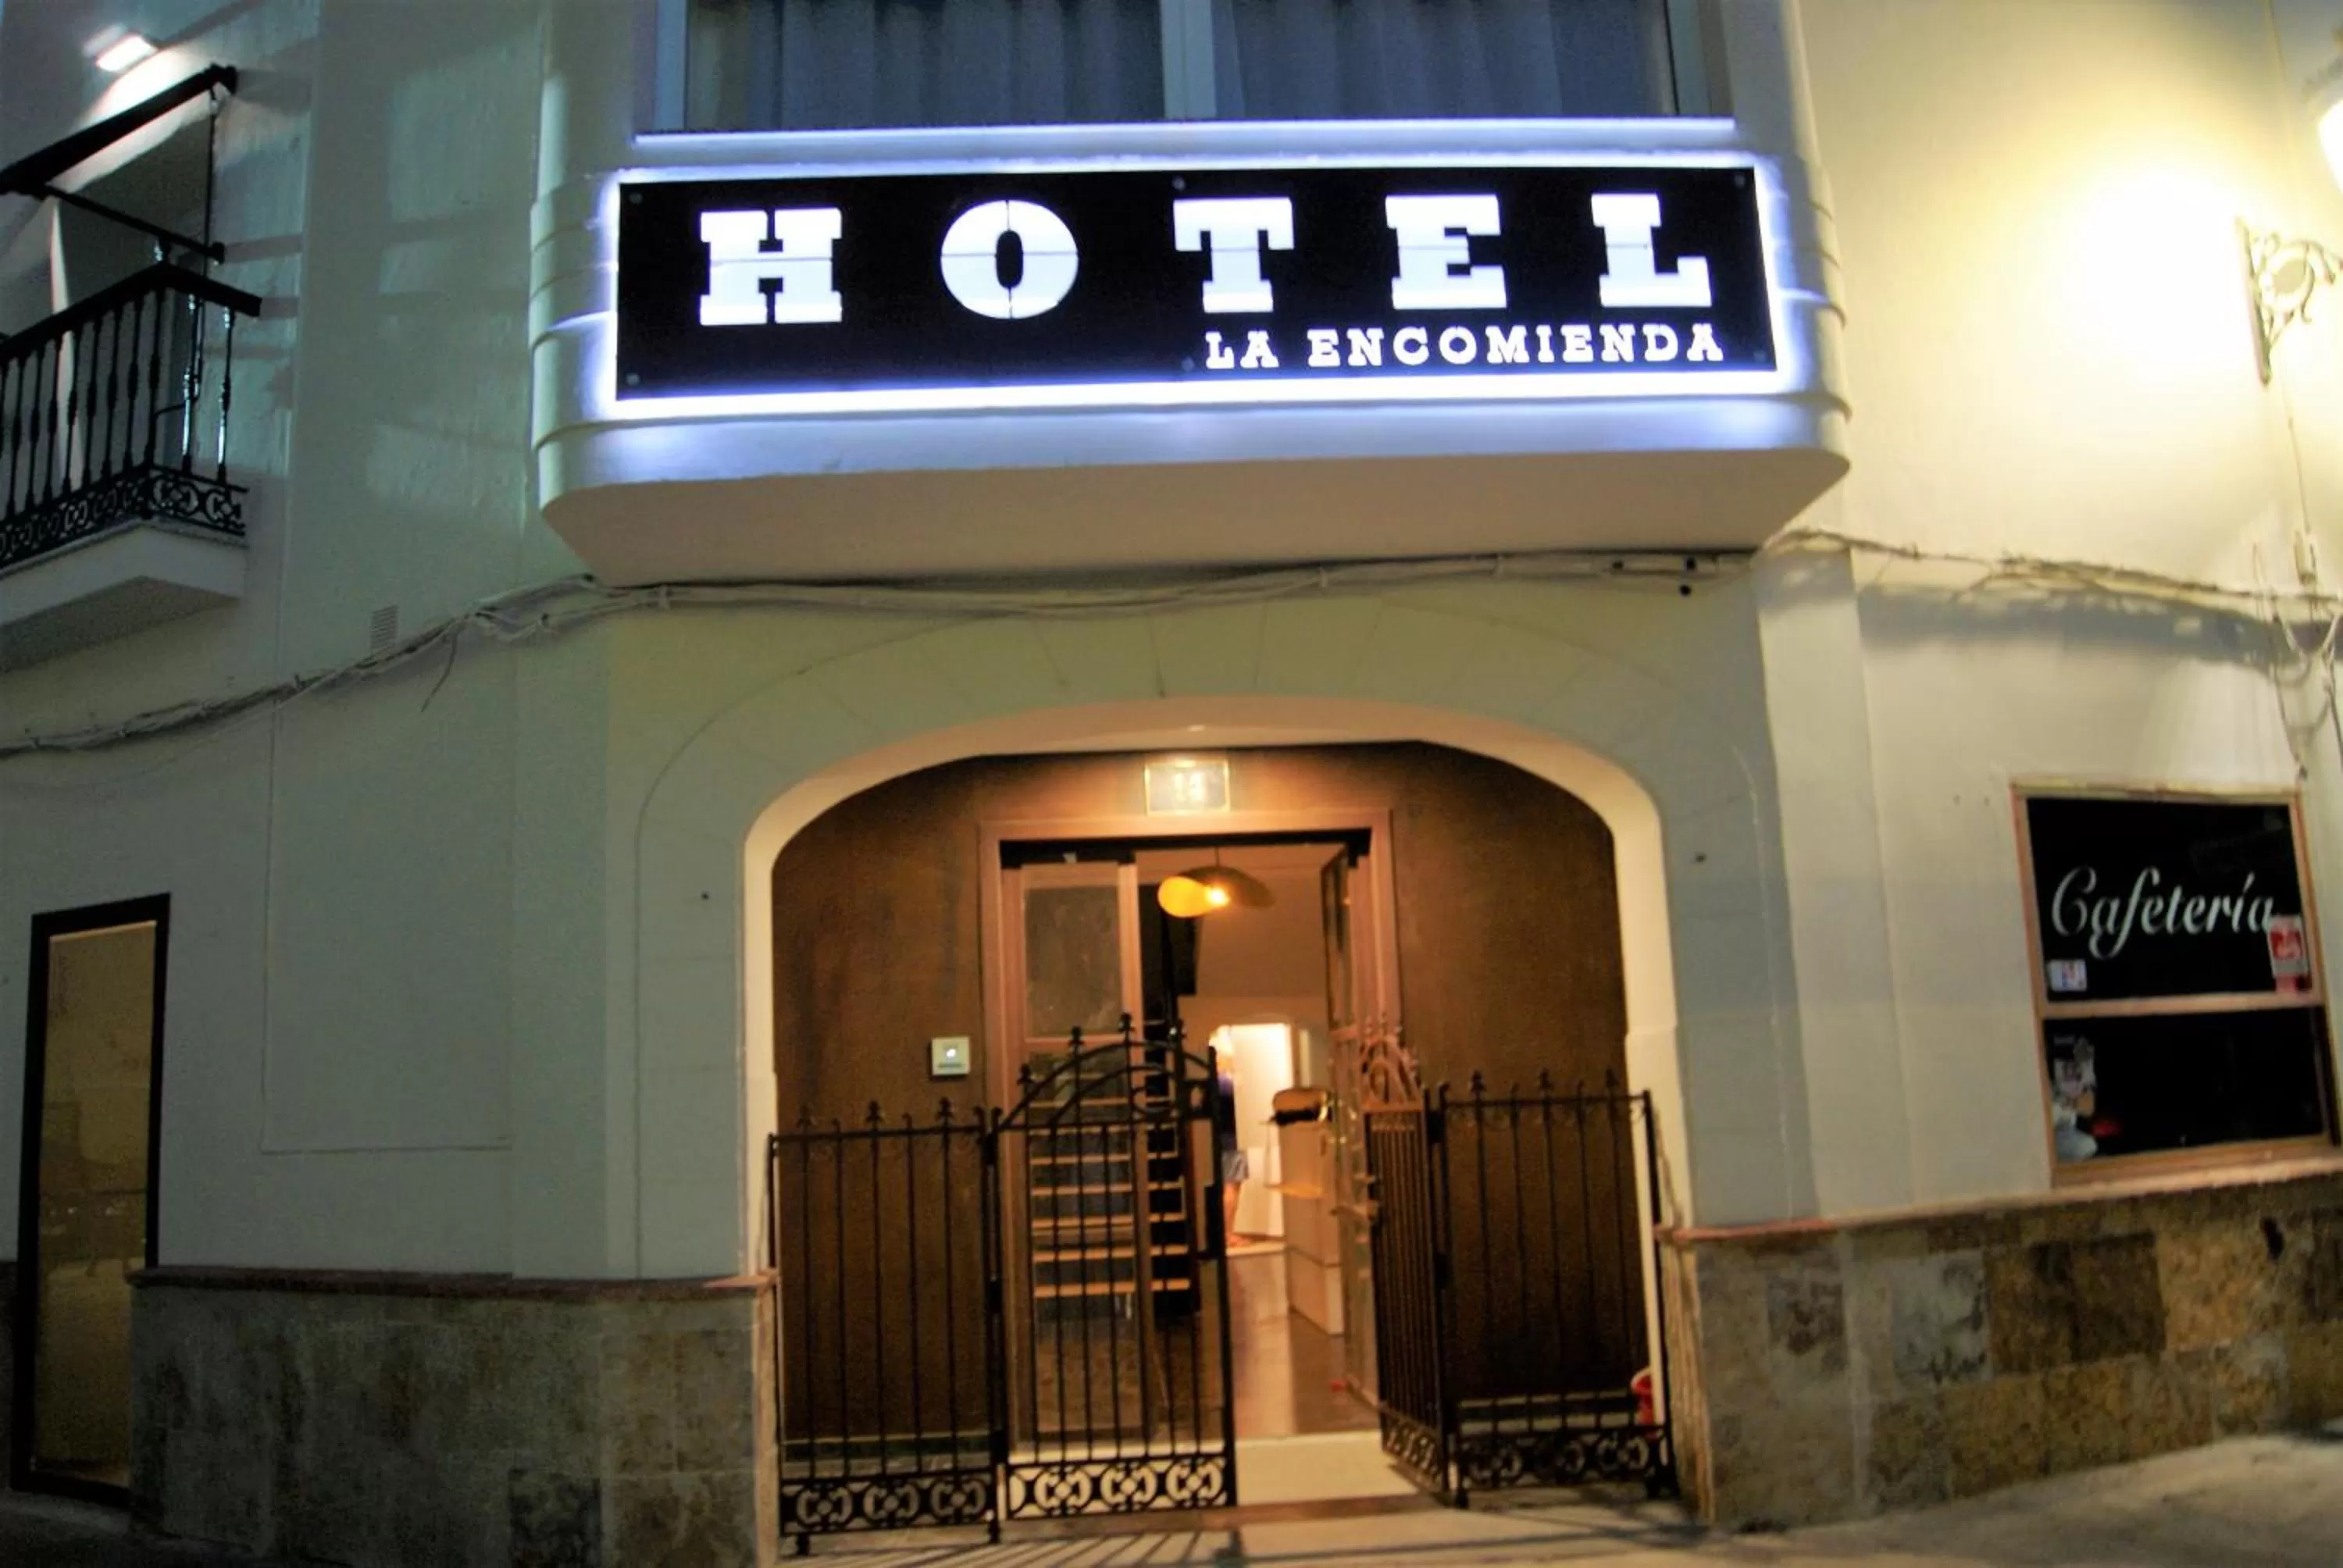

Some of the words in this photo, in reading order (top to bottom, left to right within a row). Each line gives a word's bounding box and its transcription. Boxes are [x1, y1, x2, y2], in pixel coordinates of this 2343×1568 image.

[699, 193, 1712, 326] HOTEL
[1205, 330, 1280, 369] LA
[1307, 323, 1724, 367] ENCOMIENDA
[2051, 866, 2274, 960] Cafetería
